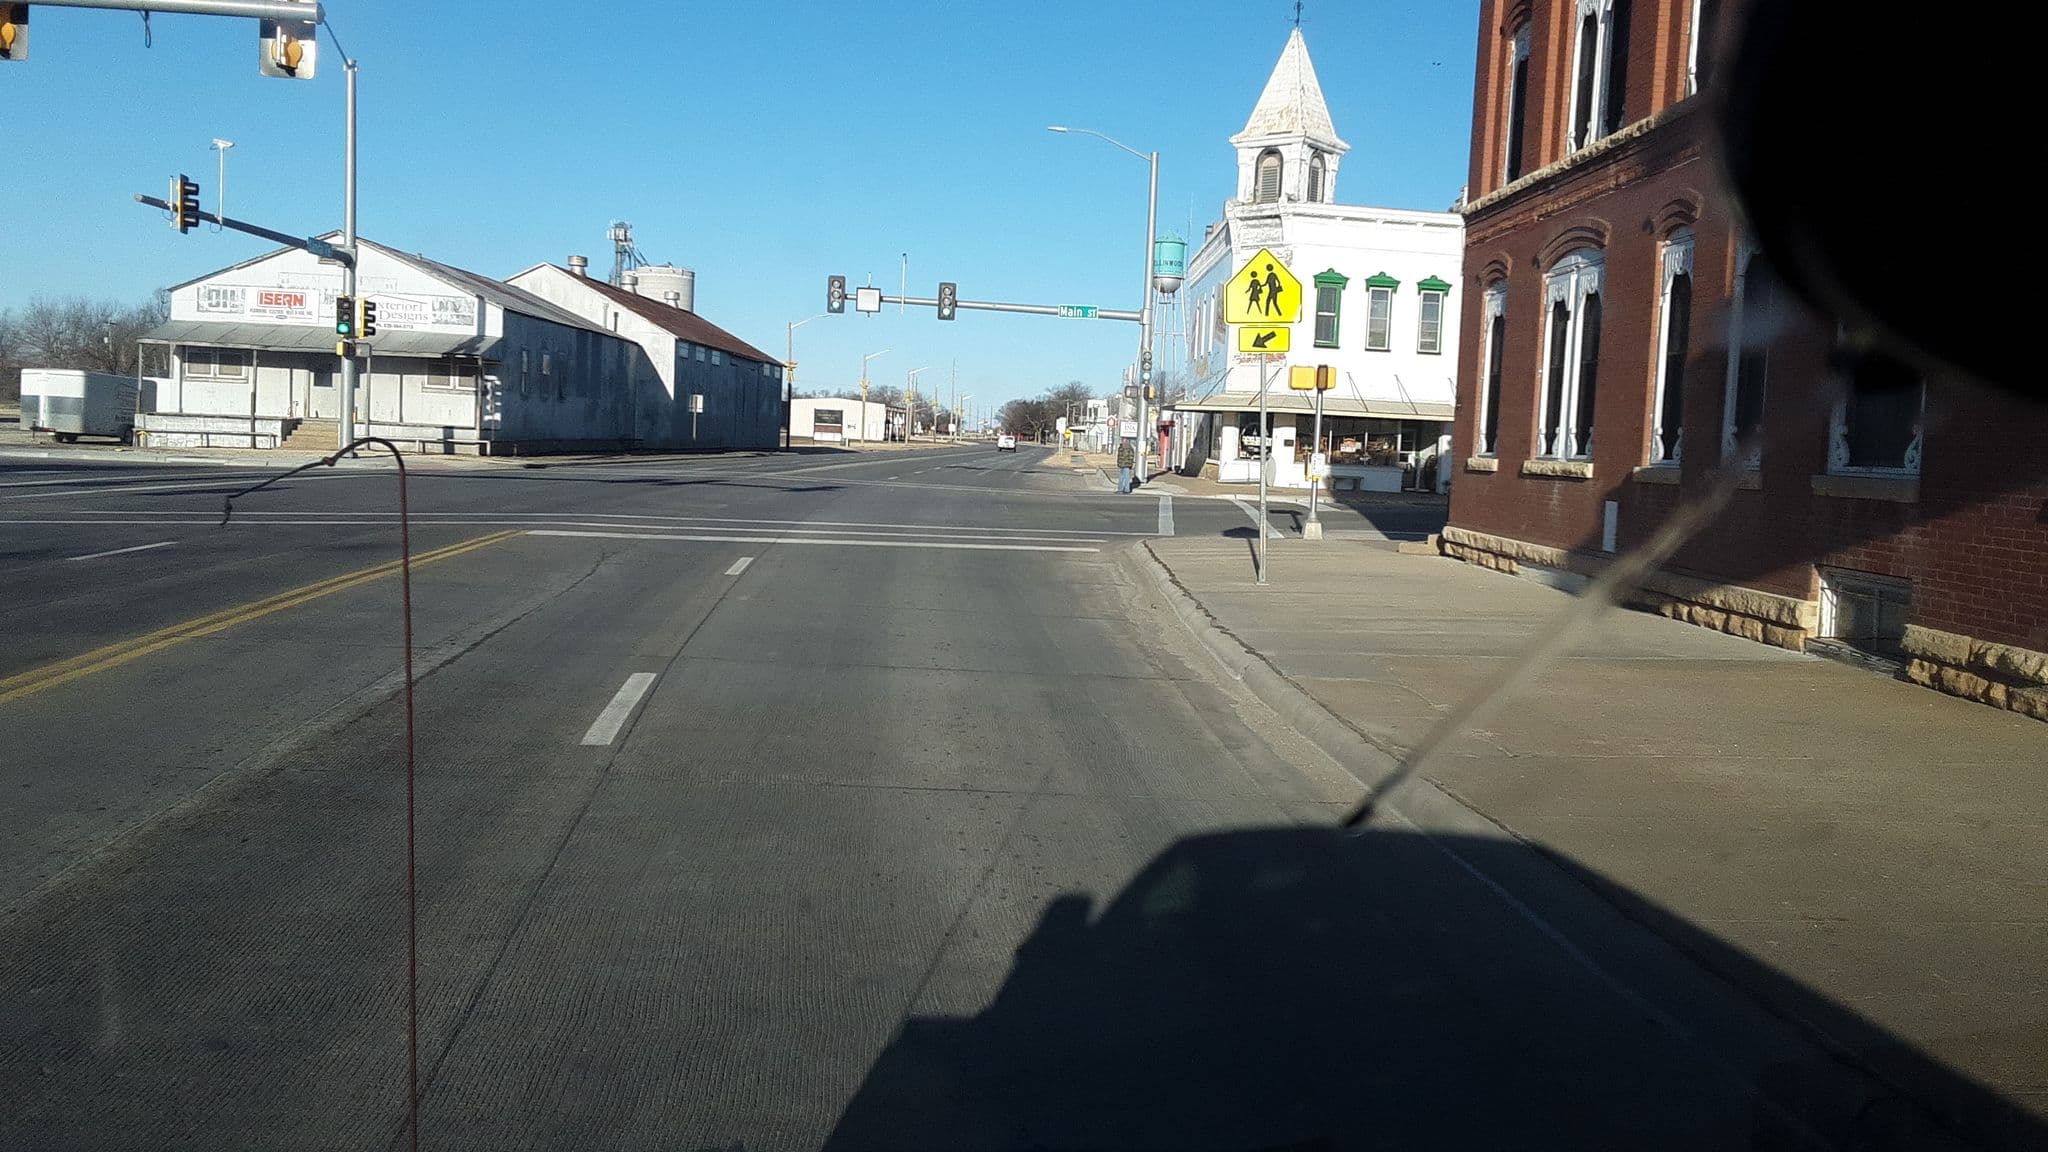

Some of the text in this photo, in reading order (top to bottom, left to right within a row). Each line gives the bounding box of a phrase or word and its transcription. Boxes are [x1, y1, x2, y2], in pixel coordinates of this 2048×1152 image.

[259, 292, 304, 308] ISERN
[379, 310, 428, 321] Designs
[1060, 306, 1083, 317] Main
